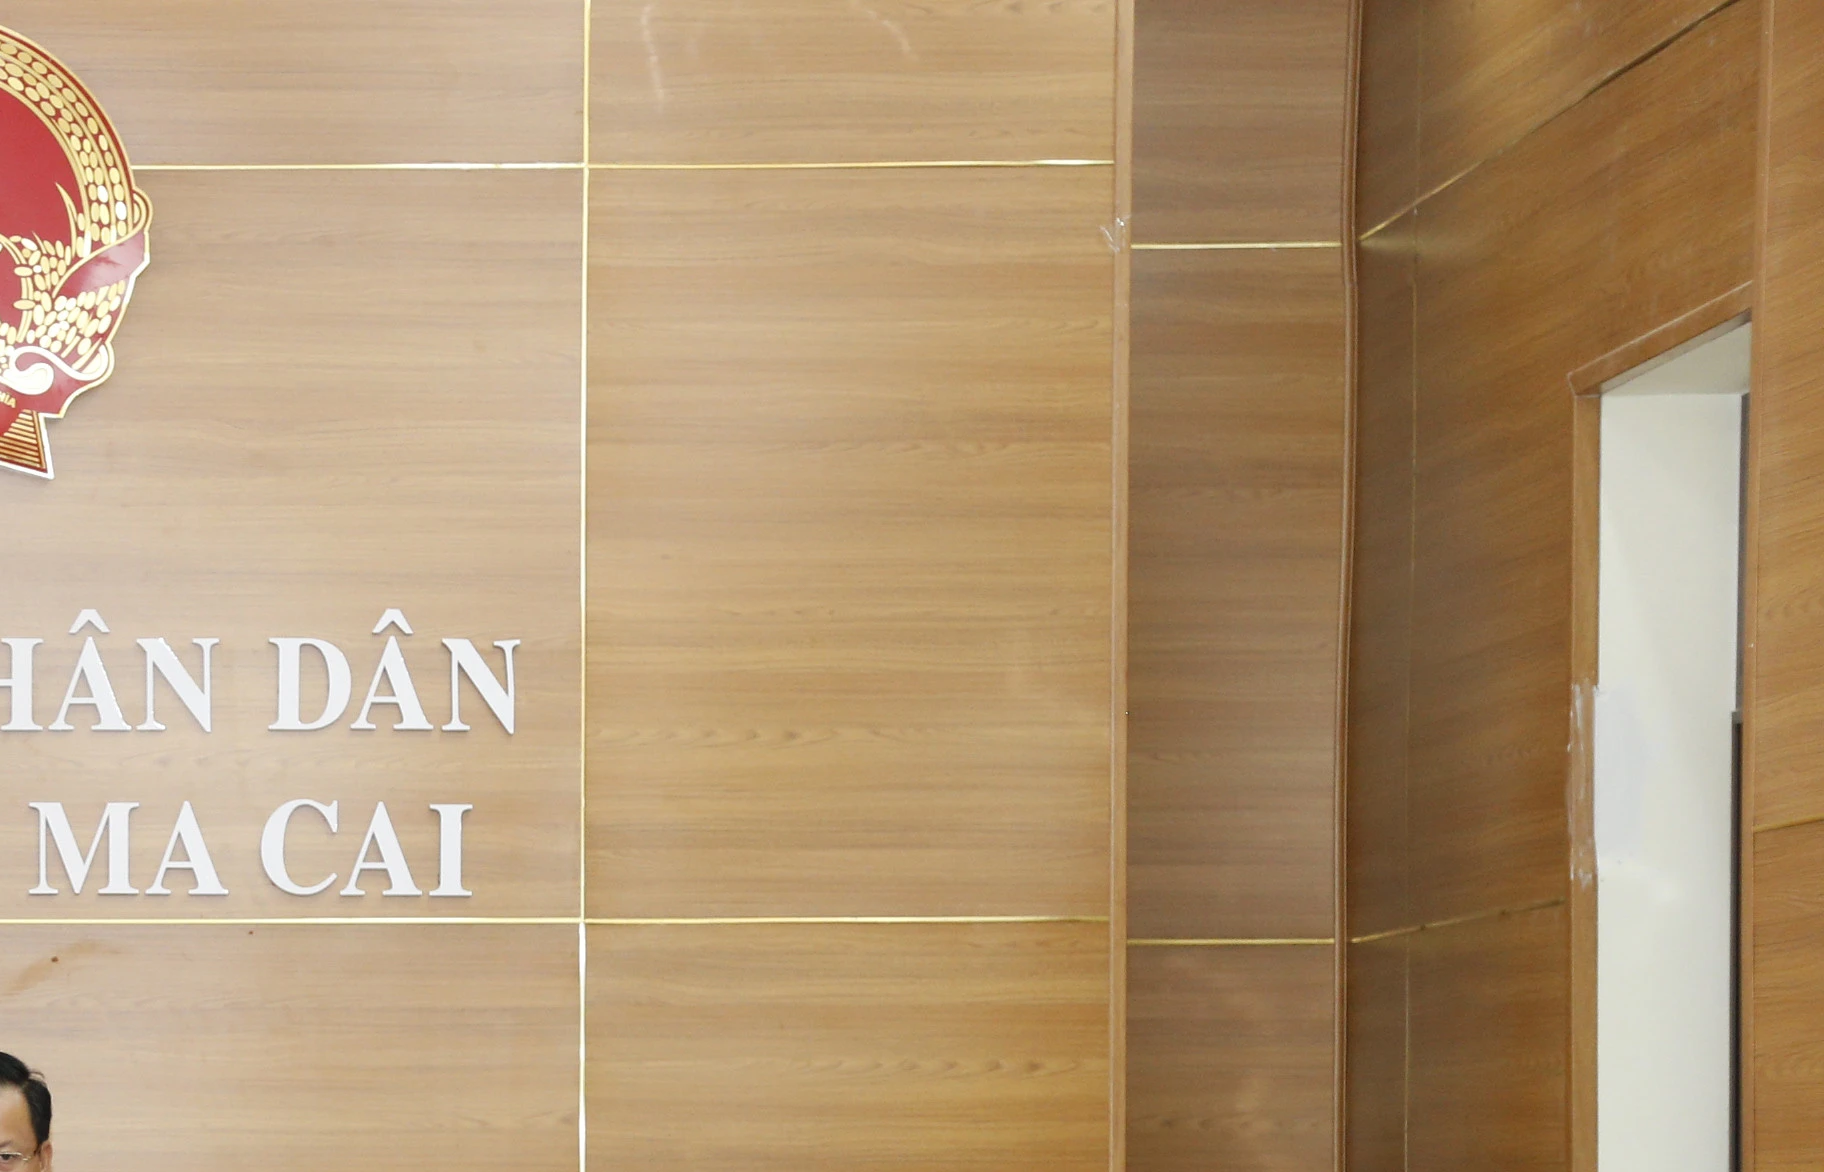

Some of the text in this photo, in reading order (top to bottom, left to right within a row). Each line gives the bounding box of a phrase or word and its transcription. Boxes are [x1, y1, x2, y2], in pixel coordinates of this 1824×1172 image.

[267, 606, 522, 736] DÂN
[28, 800, 230, 896] MA
[259, 797, 474, 898] CAI
